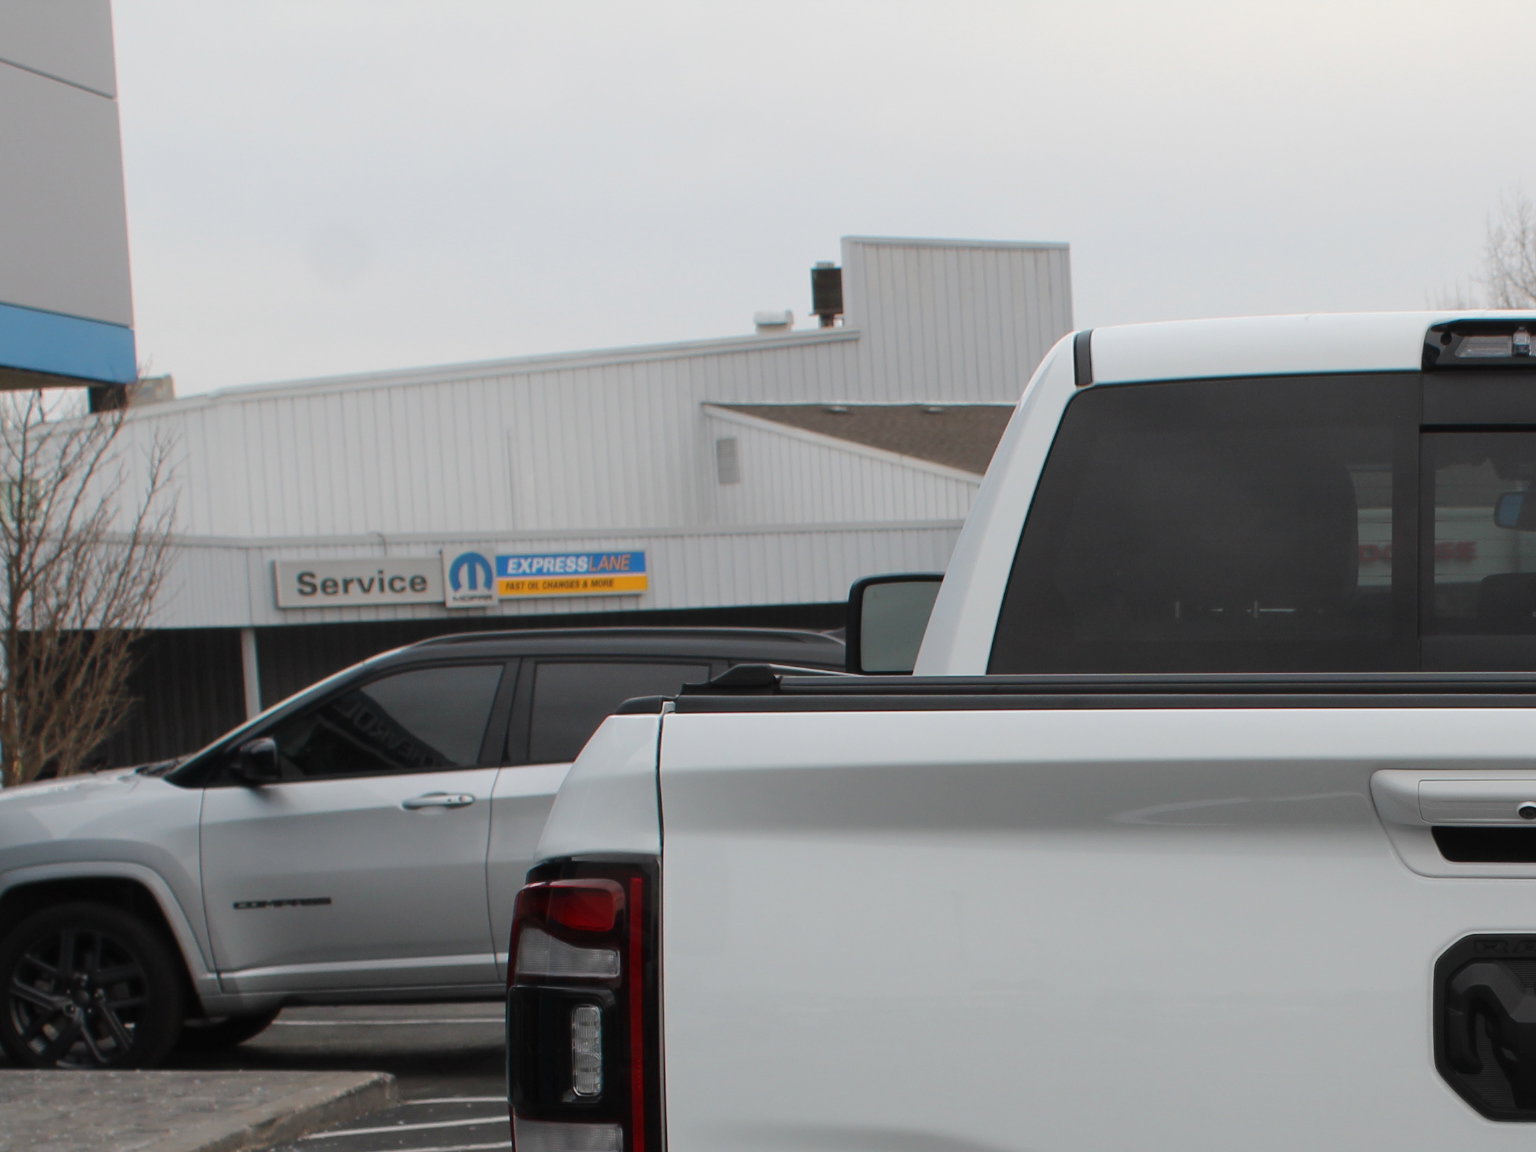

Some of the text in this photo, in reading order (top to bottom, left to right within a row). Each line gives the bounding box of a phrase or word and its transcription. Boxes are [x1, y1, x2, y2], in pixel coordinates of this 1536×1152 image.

[296, 569, 428, 597] Service
[505, 581, 525, 591] FAST
[542, 579, 580, 590] CHANGES
[590, 578, 615, 588] MORE
